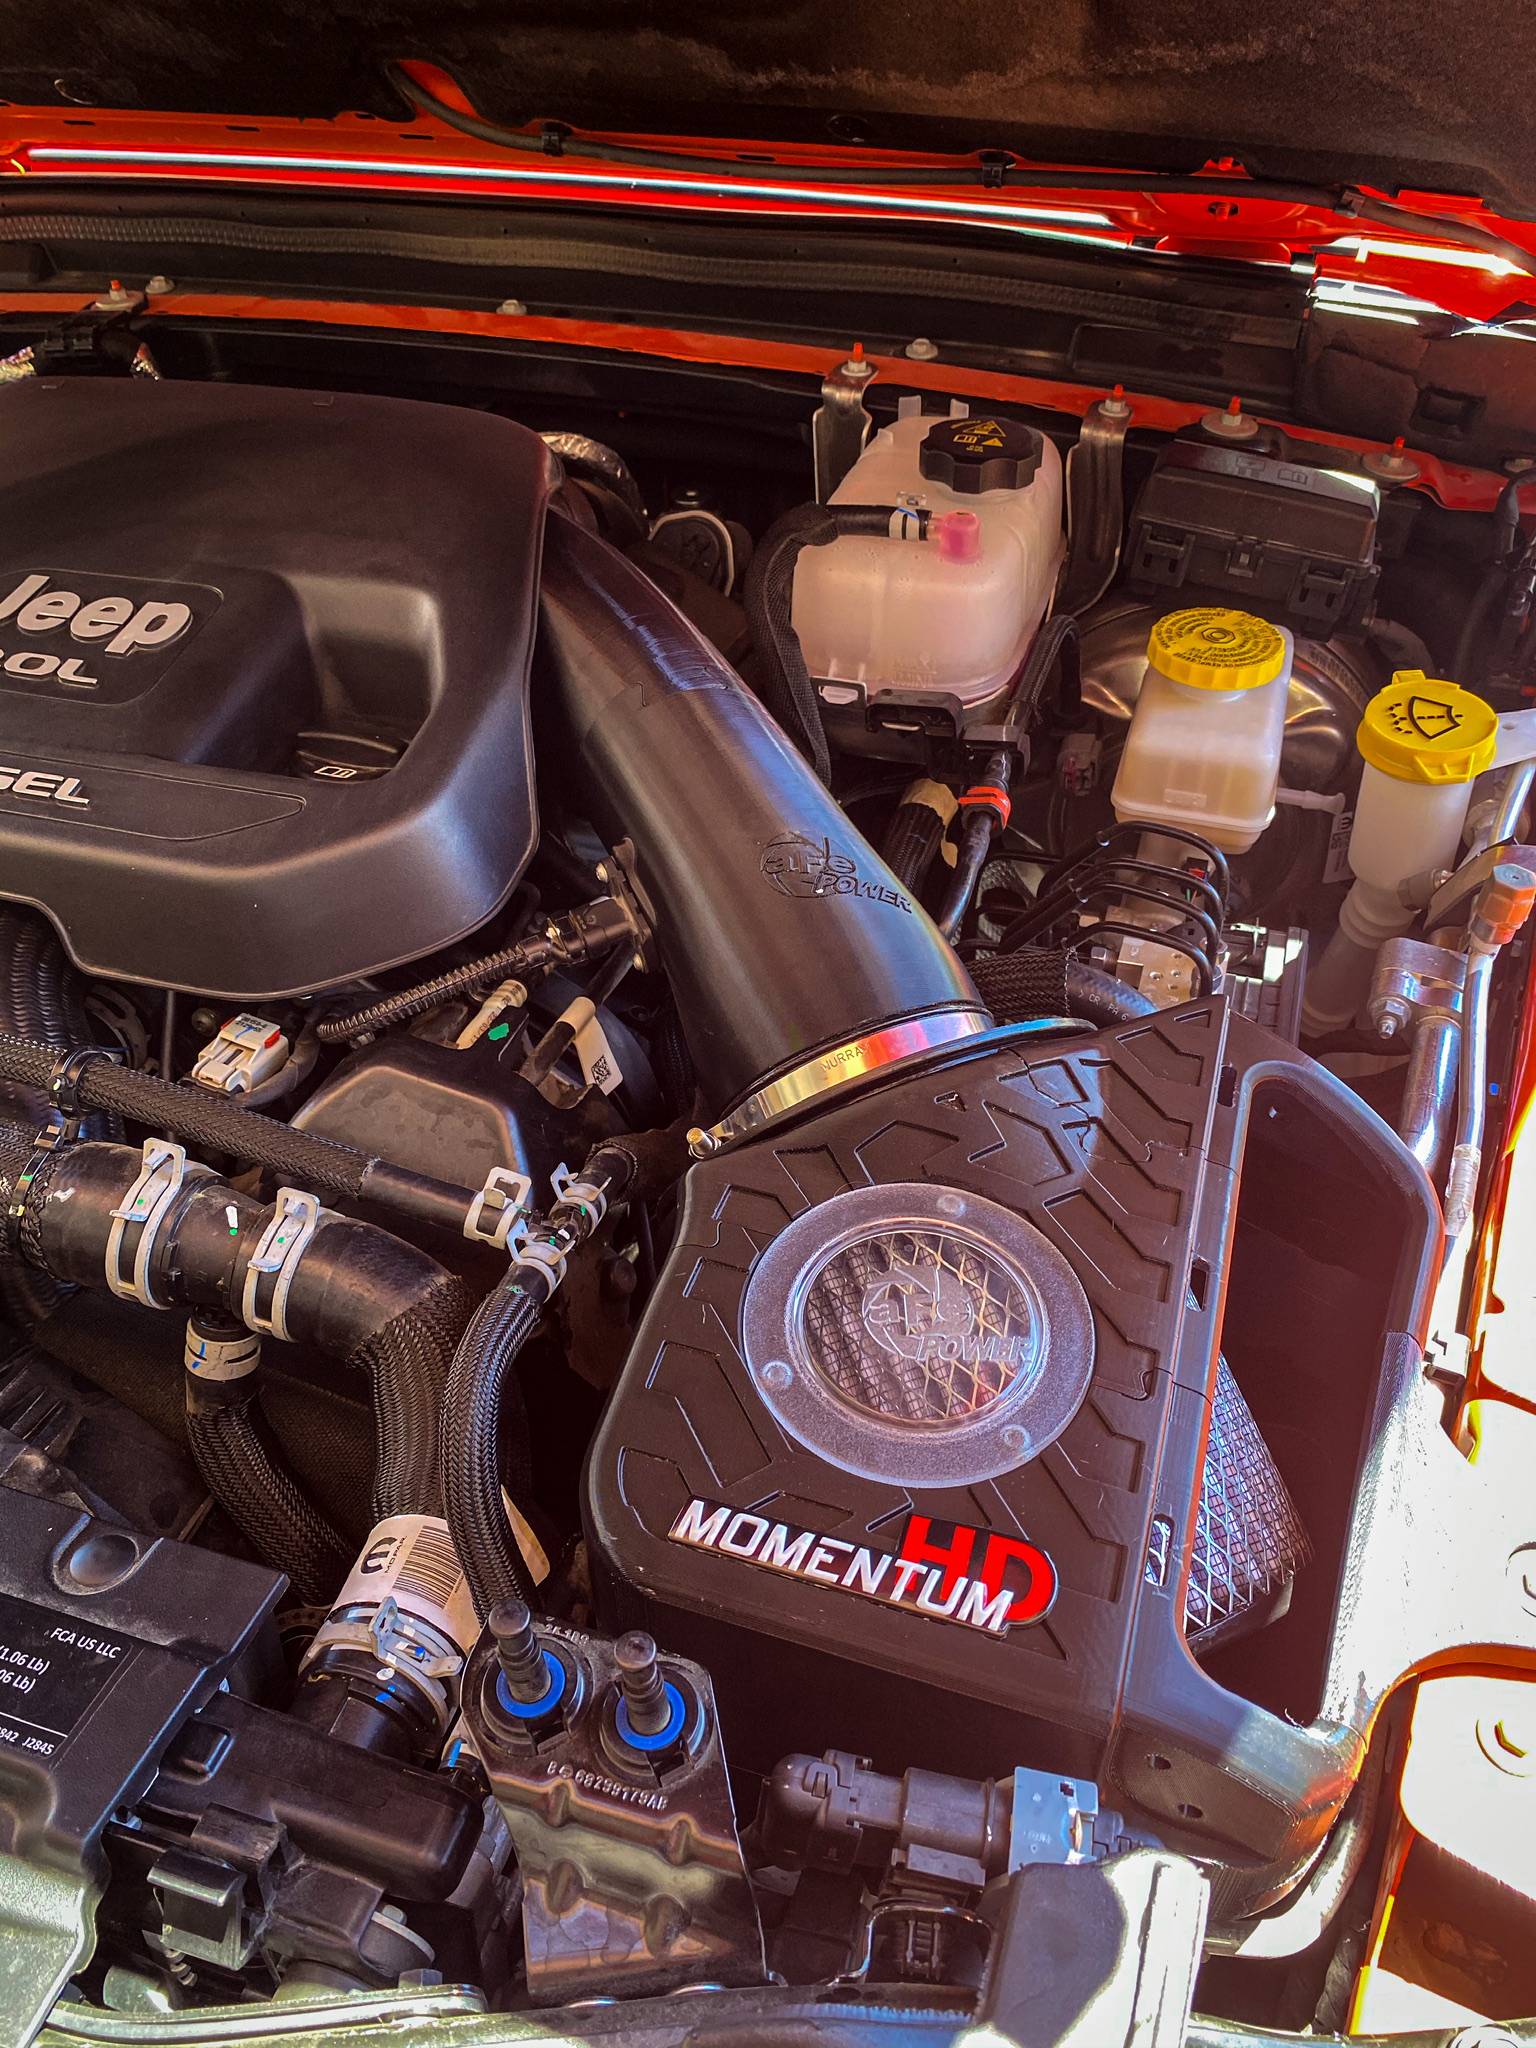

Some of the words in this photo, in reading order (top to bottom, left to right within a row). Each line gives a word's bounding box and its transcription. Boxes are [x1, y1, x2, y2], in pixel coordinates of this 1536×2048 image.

[0, 574, 193, 656] Jeep
[811, 870, 913, 915] POWER
[915, 1333, 1034, 1362] POWER
[384, 1536, 406, 1574] MOPAR
[674, 1498, 1015, 1632] MOMENTUM
[897, 1514, 1056, 1622] HD
[50, 1627, 77, 1645] FCA
[77, 1635, 99, 1651] US
[95, 1641, 122, 1659] LLC
[27, 1656, 51, 1676] Lb)
[12, 1674, 37, 1694] Lb)
[0, 1726, 19, 1743] 842
[22, 1736, 55, 1756] J2845
